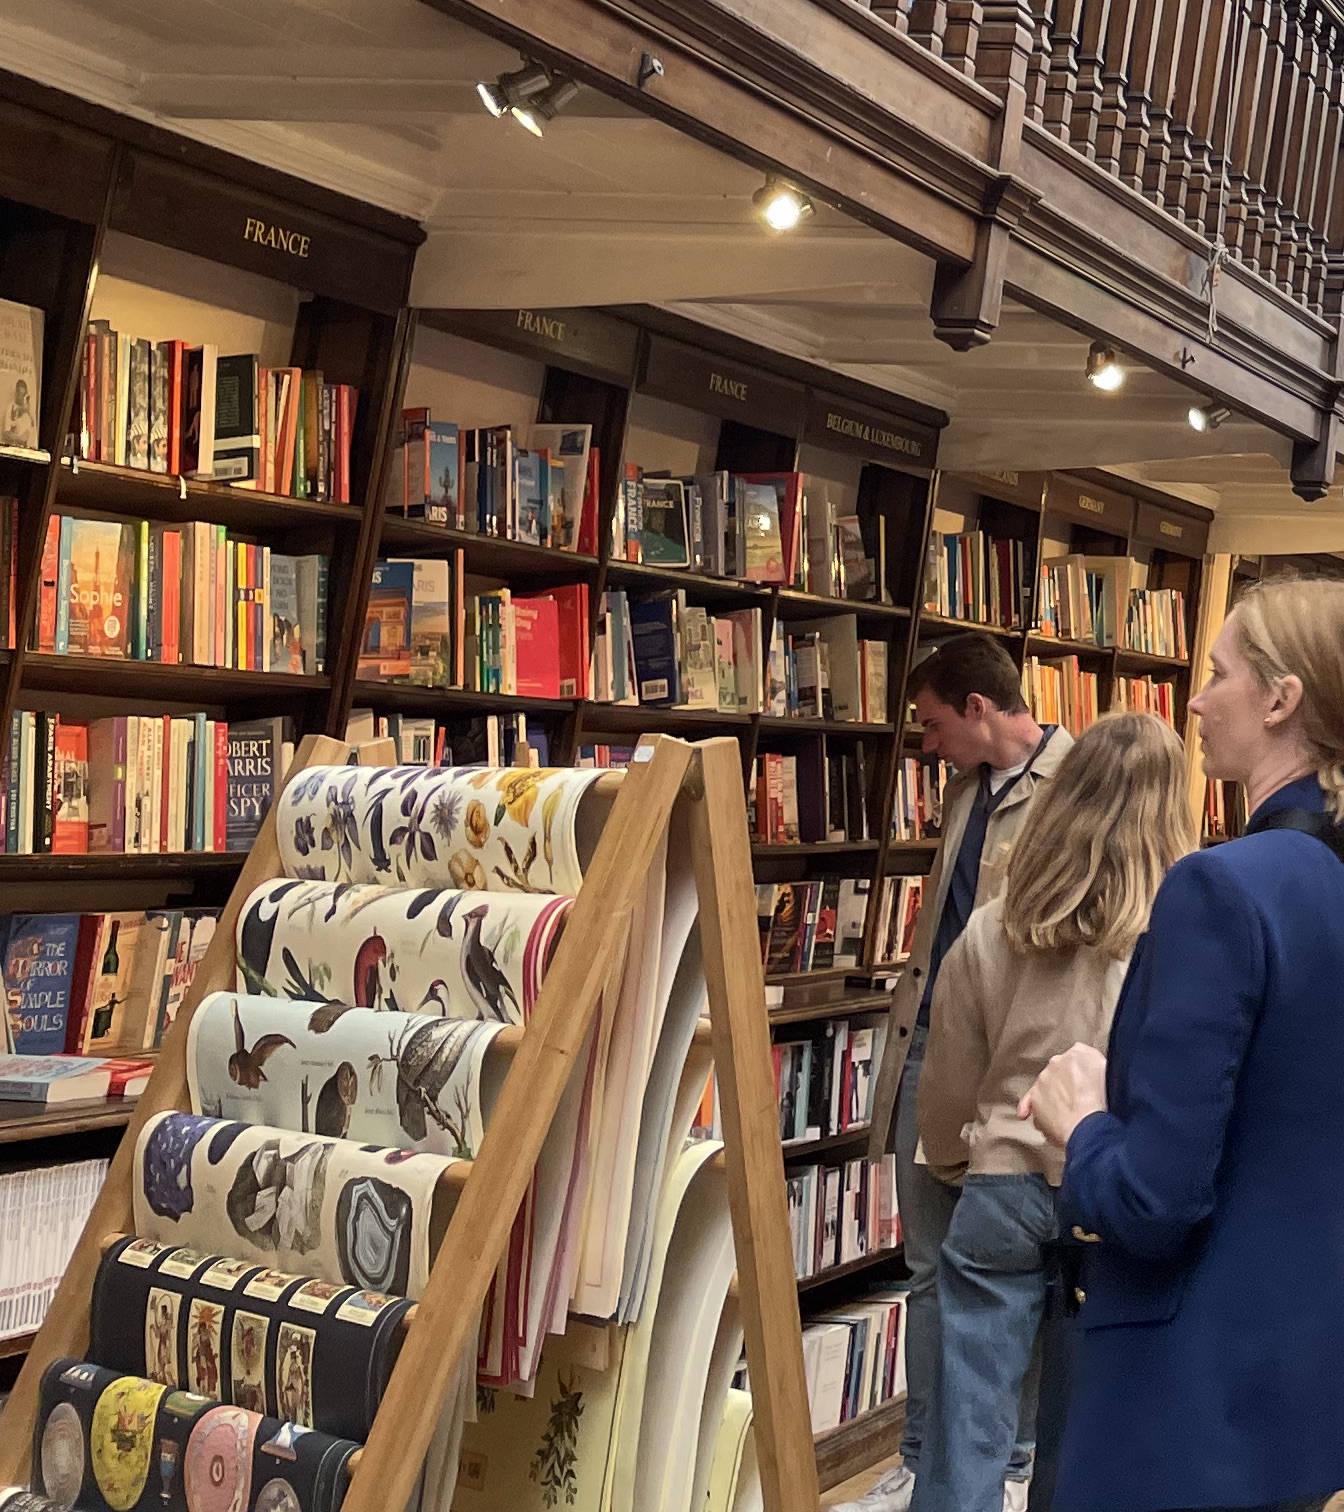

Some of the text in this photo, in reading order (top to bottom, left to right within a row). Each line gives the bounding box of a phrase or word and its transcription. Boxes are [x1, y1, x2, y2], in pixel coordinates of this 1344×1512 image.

[244, 217, 311, 258] FRANCE
[517, 309, 566, 341] FRANCE
[710, 373, 748, 401] FRANCE
[826, 413, 862, 439] BELGIUM
[871, 432, 922, 456] LUXEMBOURG
[427, 506, 448, 522] ARIS
[626, 480, 638, 533] FRANCE
[70, 583, 122, 610] Sophie
[46, 724, 55, 753] PARIS
[227, 739, 271, 757] OBERT
[227, 758, 271, 776] ARRIS
[45, 753, 54, 811] APARTMENT
[229, 783, 270, 797] FICER
[229, 798, 263, 818] SPY
[45, 942, 65, 957] THE
[7, 989, 65, 1010] SIMPLE
[9, 1013, 63, 1033] SOULS
